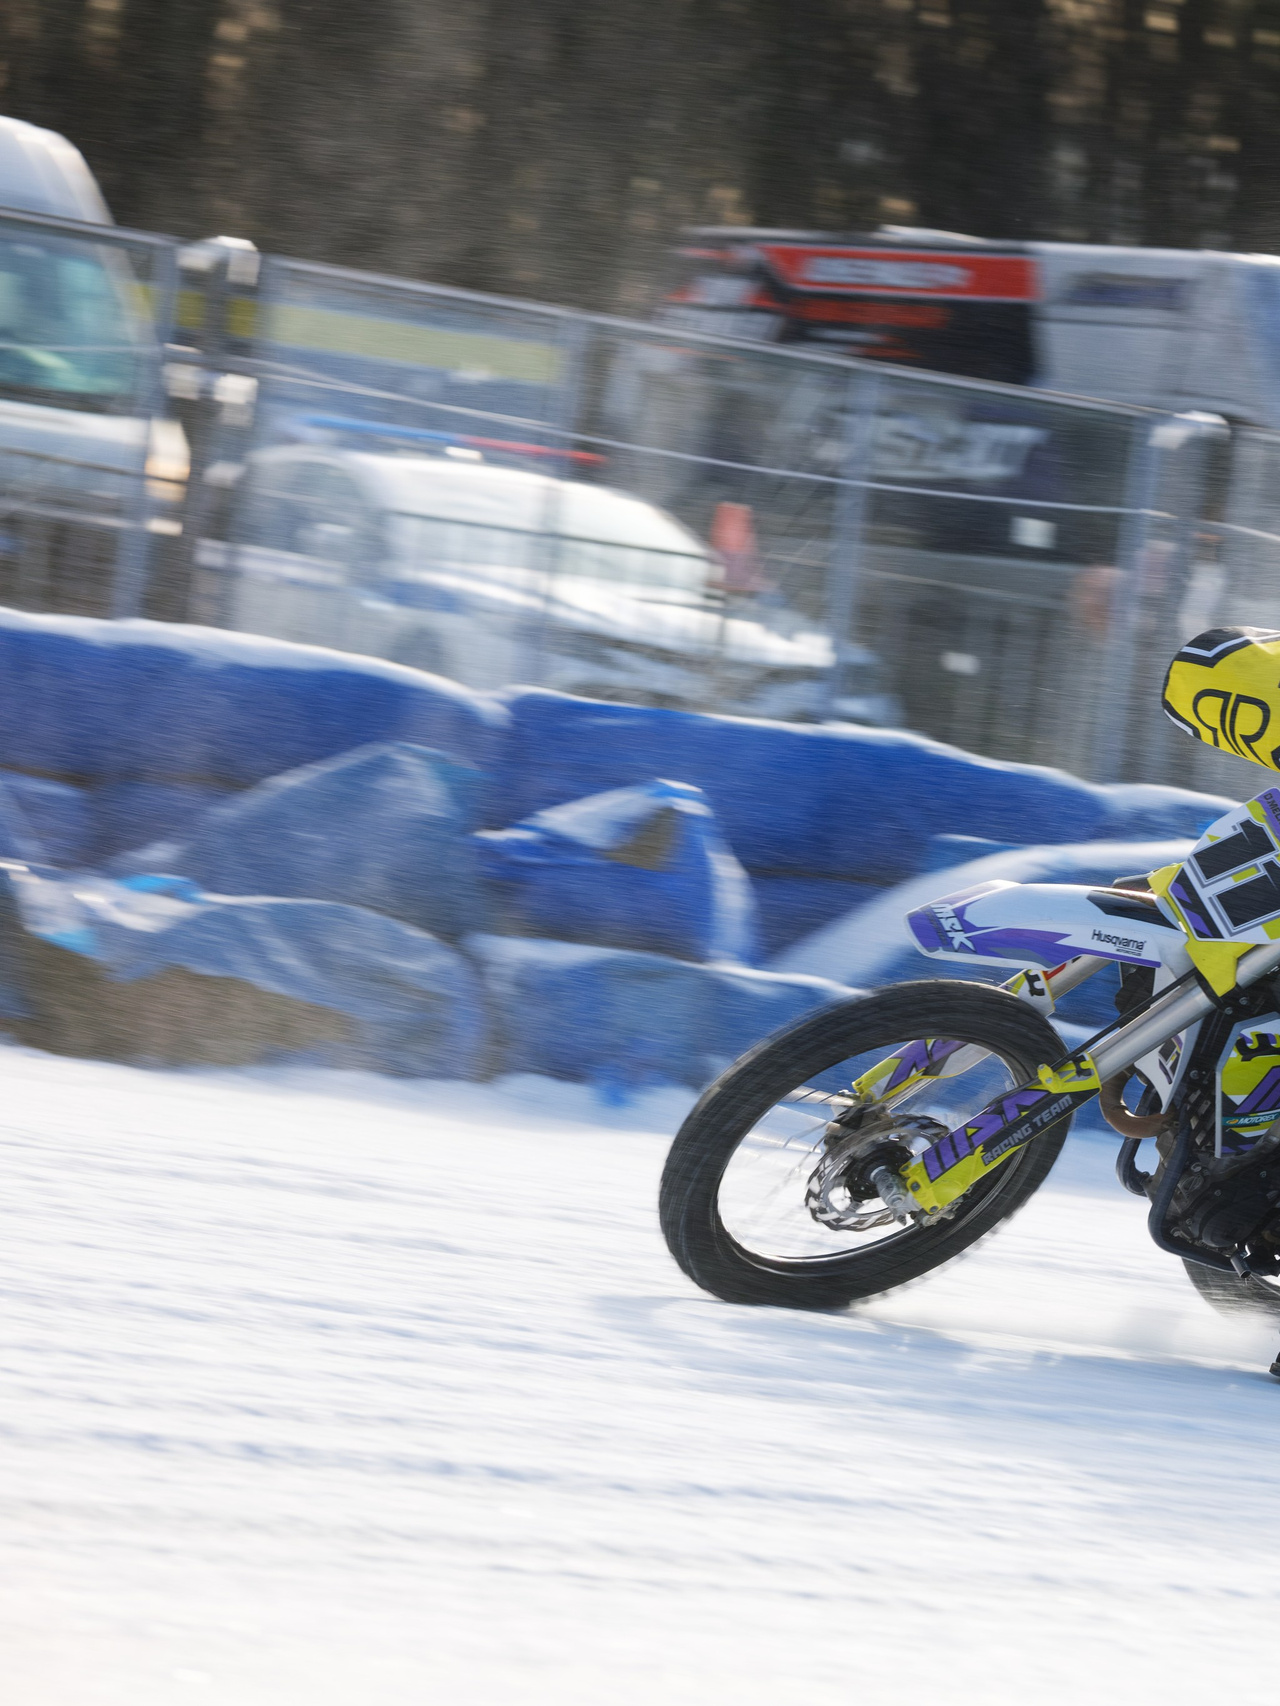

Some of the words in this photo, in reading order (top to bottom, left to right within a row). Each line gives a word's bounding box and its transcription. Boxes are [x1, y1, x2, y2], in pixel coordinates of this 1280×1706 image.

[1090, 928, 1146, 951] Husqvarna
[981, 1124, 1033, 1166] RACING
[1031, 1094, 1074, 1128] TEAM
[1237, 1113, 1278, 1125] MOTOREX
